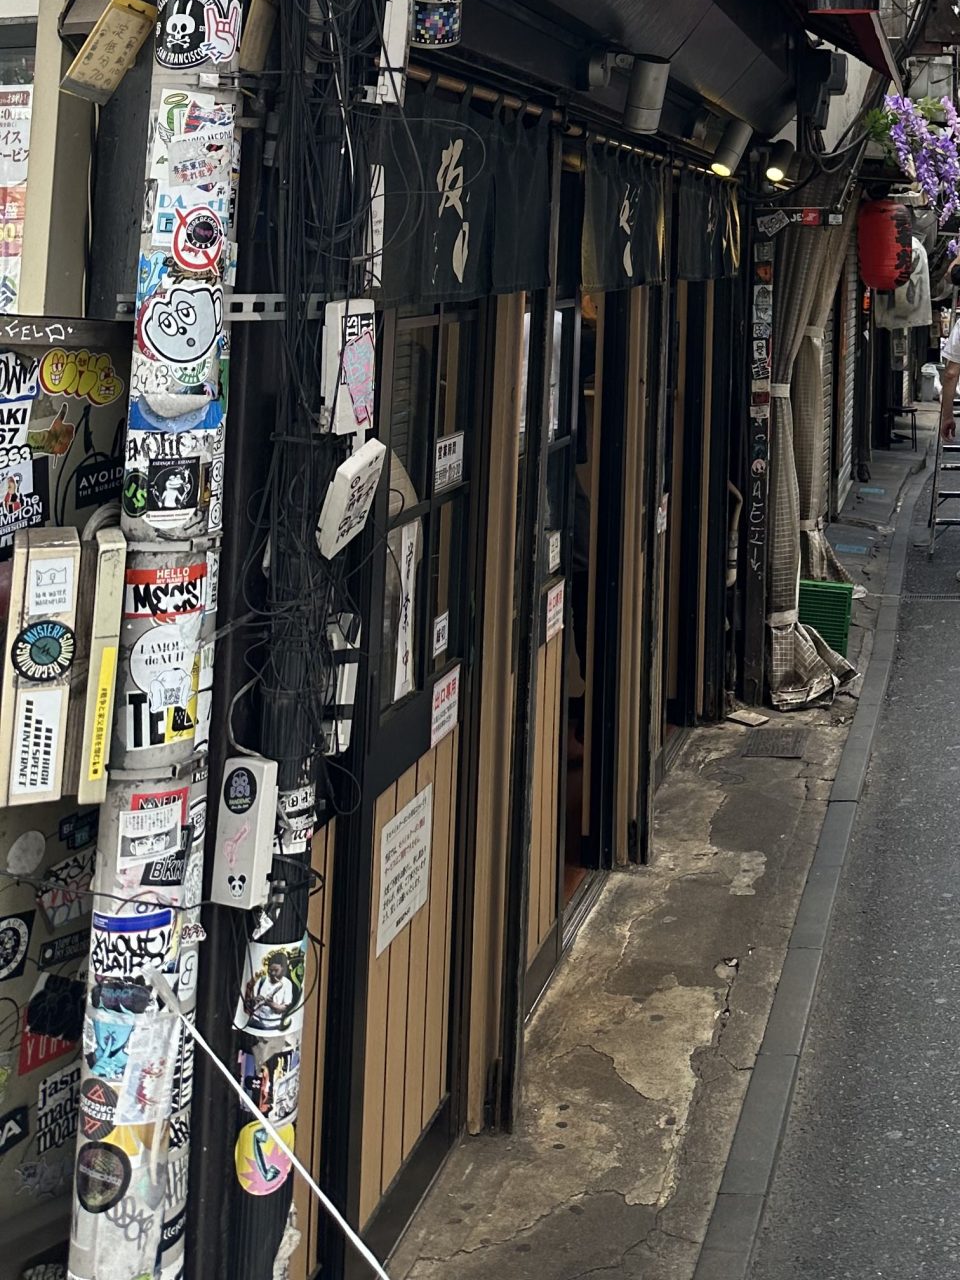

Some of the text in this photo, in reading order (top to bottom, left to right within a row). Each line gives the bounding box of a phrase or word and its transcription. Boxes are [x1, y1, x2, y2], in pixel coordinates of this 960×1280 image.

[166, 46, 204, 64] FRANCISCO
[0, 148, 30, 163] ービス
[79, 466, 124, 489] AVOID
[156, 567, 190, 580] HELLO
[16, 623, 75, 678] MYSTERY SOUND RECORDINGS
[18, 729, 31, 787] INTERNET
[29, 748, 41, 787] SPEED
[40, 757, 51, 786] HIGH
